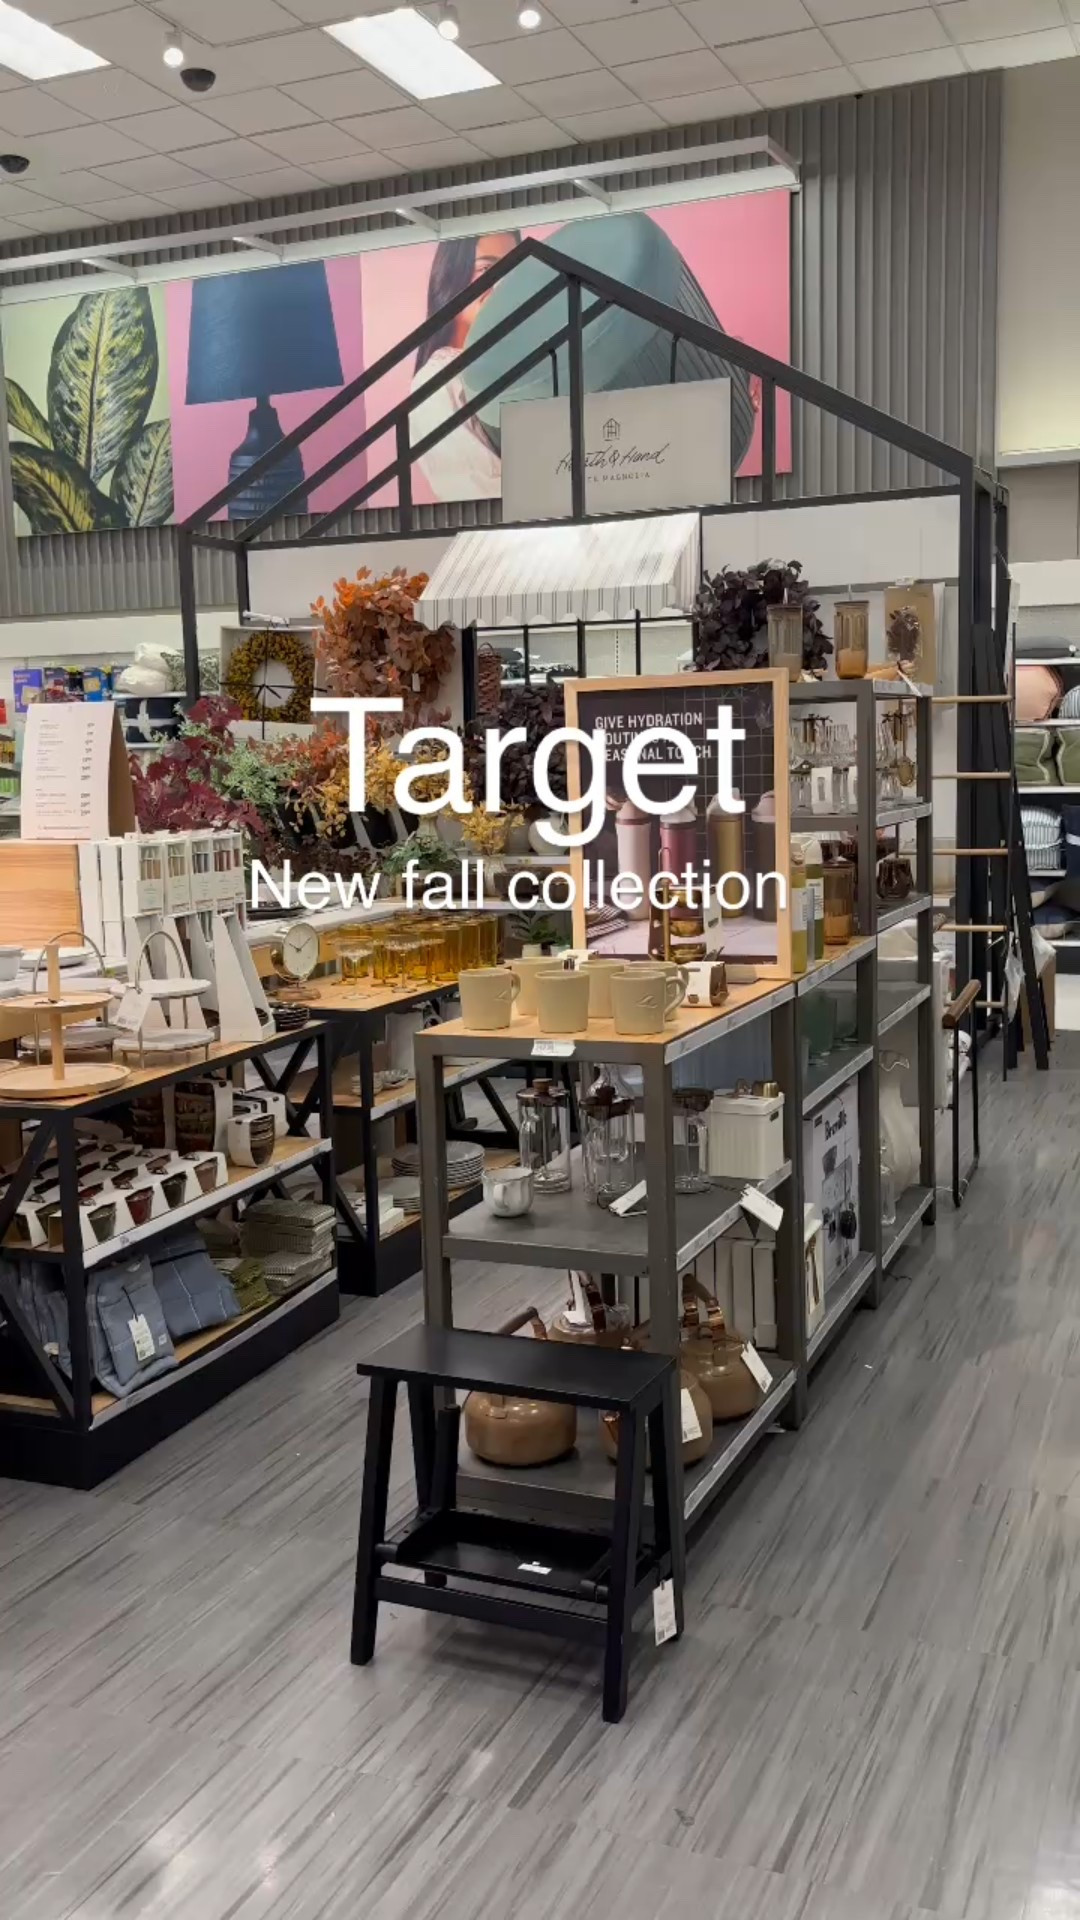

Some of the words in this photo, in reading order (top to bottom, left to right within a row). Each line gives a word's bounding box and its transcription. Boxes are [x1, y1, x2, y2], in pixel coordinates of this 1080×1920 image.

[608, 449, 621, 468] &
[620, 442, 670, 467] Hand
[594, 715, 625, 730] GIVE
[628, 711, 703, 728] HYDRATION
[667, 744, 712, 760] TOCH
